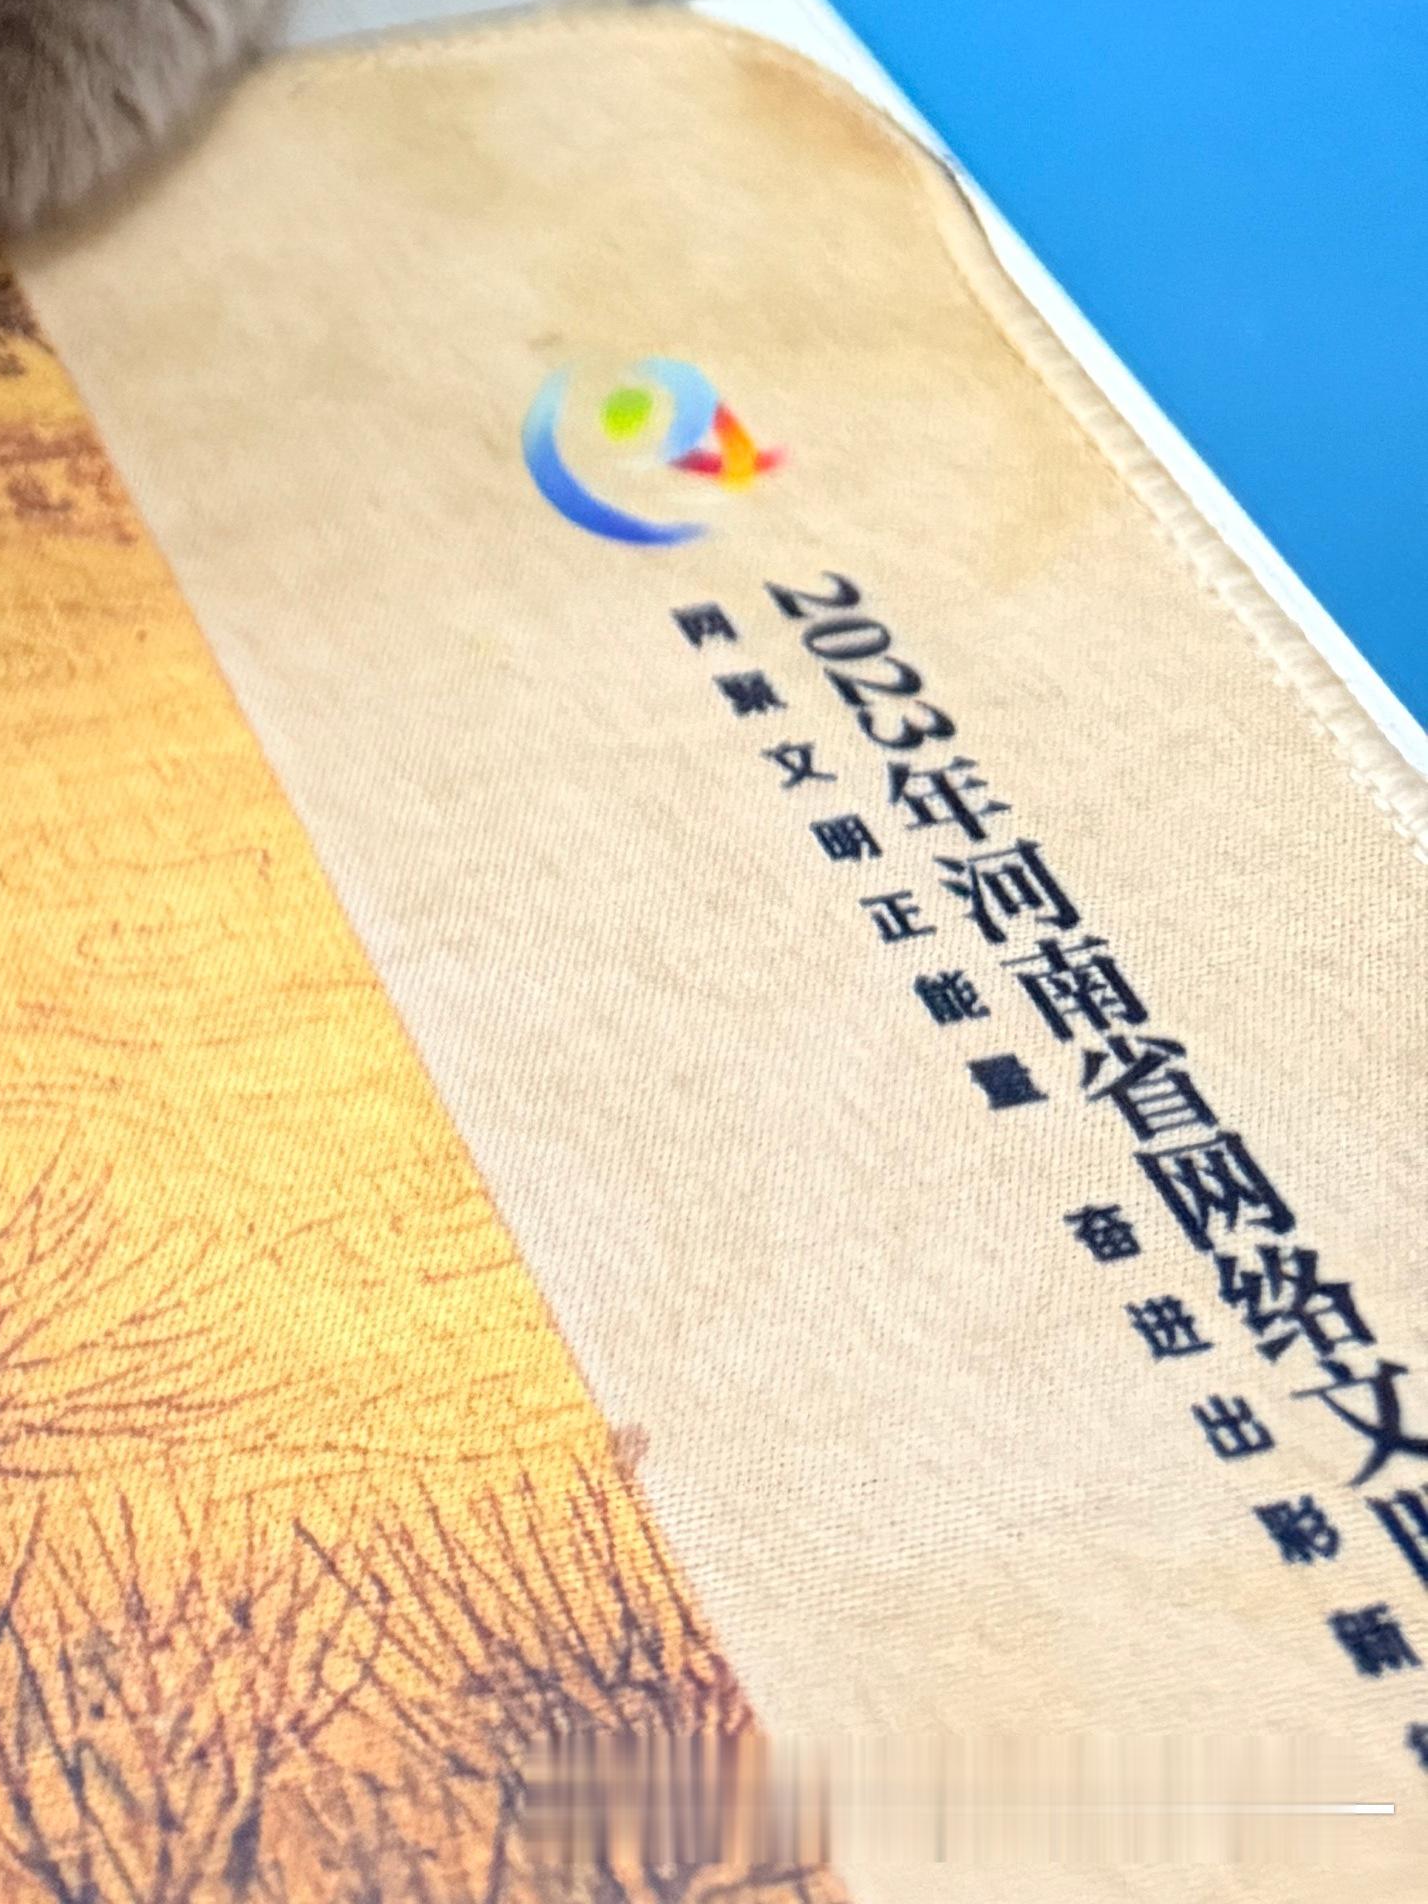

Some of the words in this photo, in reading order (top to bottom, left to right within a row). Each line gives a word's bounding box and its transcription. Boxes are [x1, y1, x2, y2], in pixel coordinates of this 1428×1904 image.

[1062, 1204, 1428, 1776] 奋进出彩新
